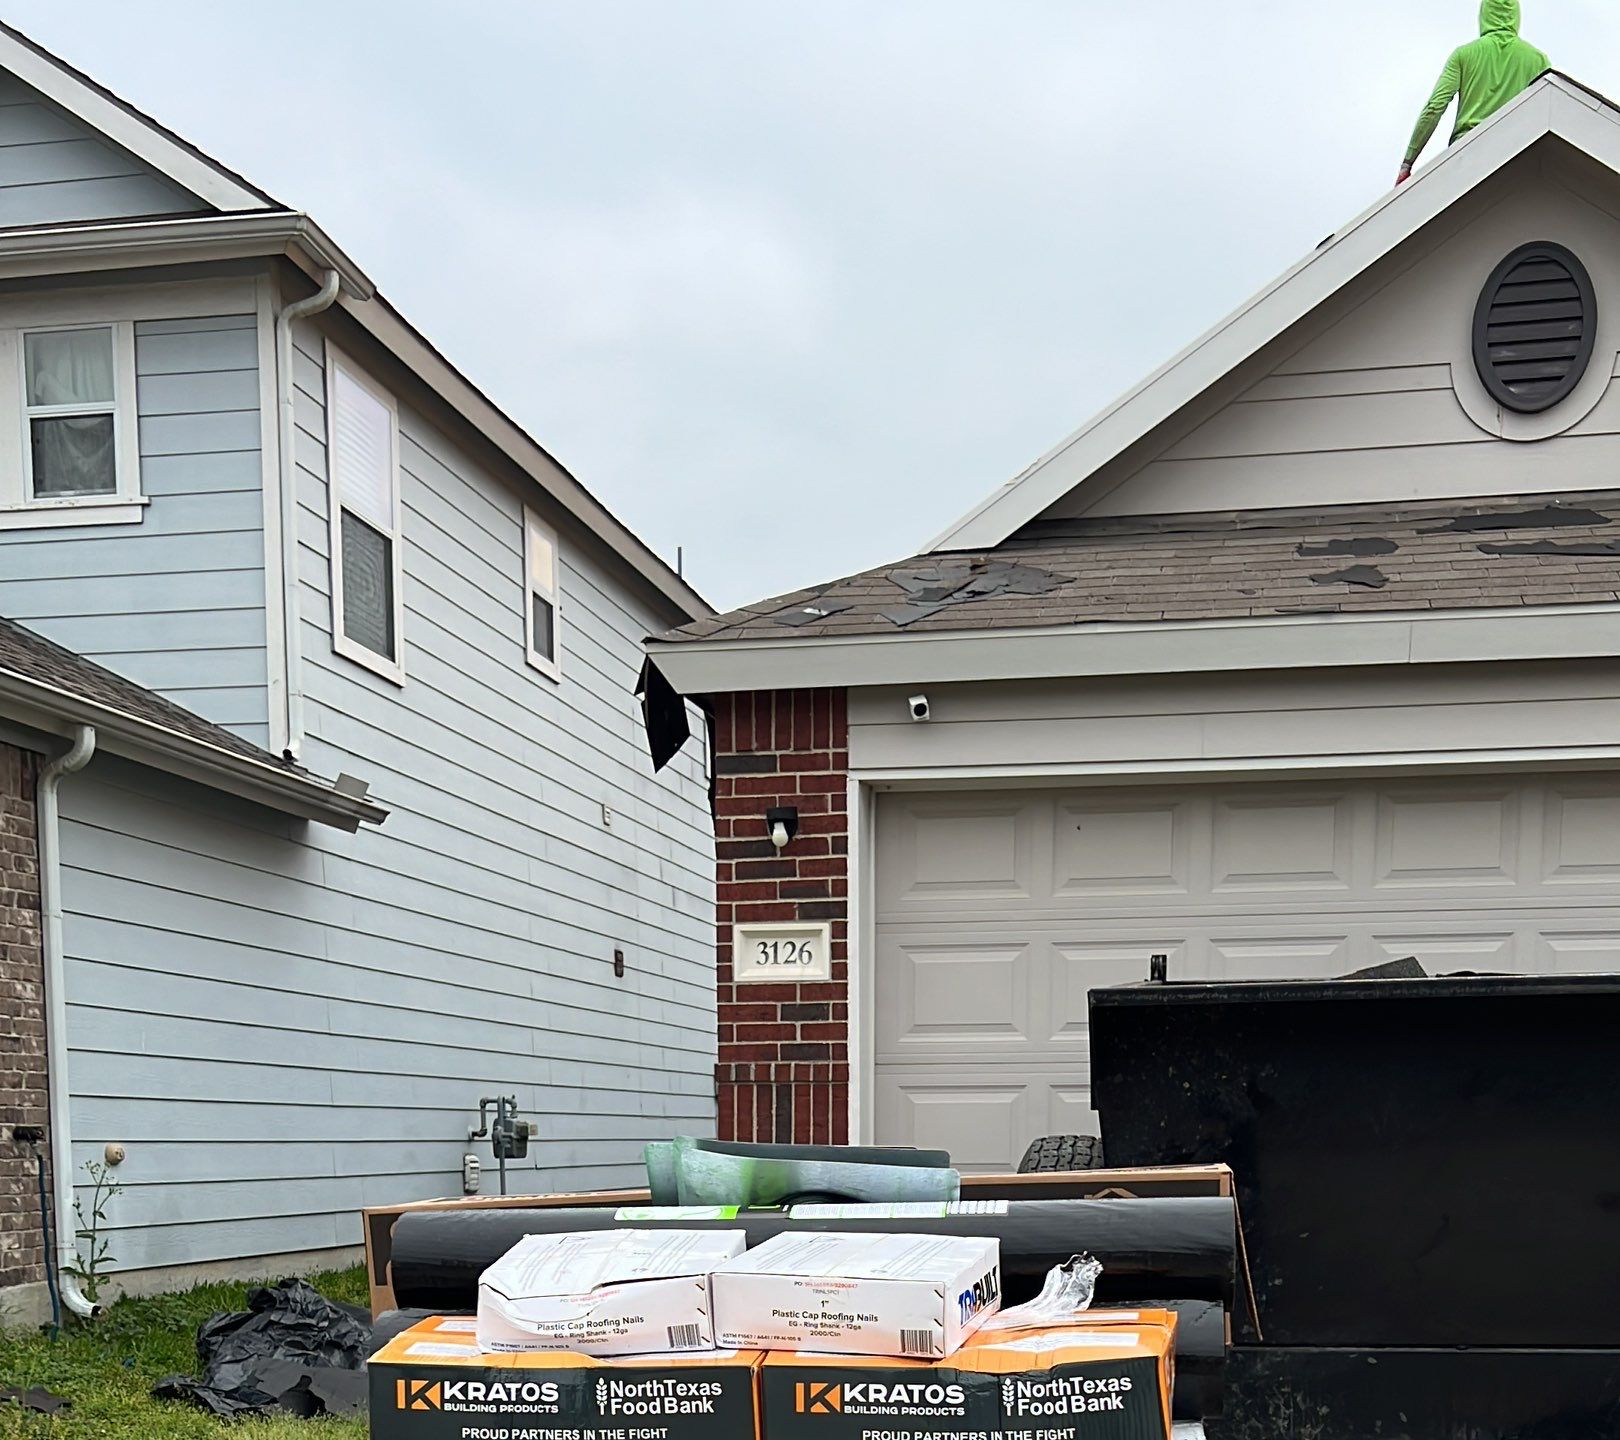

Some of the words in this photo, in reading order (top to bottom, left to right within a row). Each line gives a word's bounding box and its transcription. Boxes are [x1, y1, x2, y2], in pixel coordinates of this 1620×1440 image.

[756, 941, 813, 965] 3126
[772, 1309, 800, 1319] Plastic
[802, 1311, 819, 1320] Cap
[821, 1312, 854, 1323] Roofing
[856, 1313, 879, 1322] Nails
[537, 1322, 565, 1331] Plastic
[567, 1322, 585, 1332] Cap
[586, 1319, 621, 1329] Roofing
[622, 1316, 645, 1325] Nails
[803, 1321, 819, 1329] Ring
[846, 1323, 862, 1331] 12ga
[443, 1381, 559, 1402] KRATOS
[844, 1383, 965, 1404] KRATOS
[443, 1402, 497, 1413] BUILDING
[500, 1402, 559, 1414] PRODUCTS
[610, 1398, 661, 1416] Food
[664, 1397, 715, 1414] Bank
[843, 1405, 898, 1415] BUILDING
[901, 1406, 966, 1417] PRODUCTS
[1017, 1398, 1068, 1417] Food
[1072, 1393, 1124, 1414] Bank
[461, 1427, 509, 1440] PROUD
[511, 1429, 580, 1440] PARTNERS
[583, 1429, 596, 1440] IN
[598, 1428, 625, 1440] THE
[629, 1427, 668, 1439] FIGHT
[1036, 1428, 1076, 1440] FIGHT
